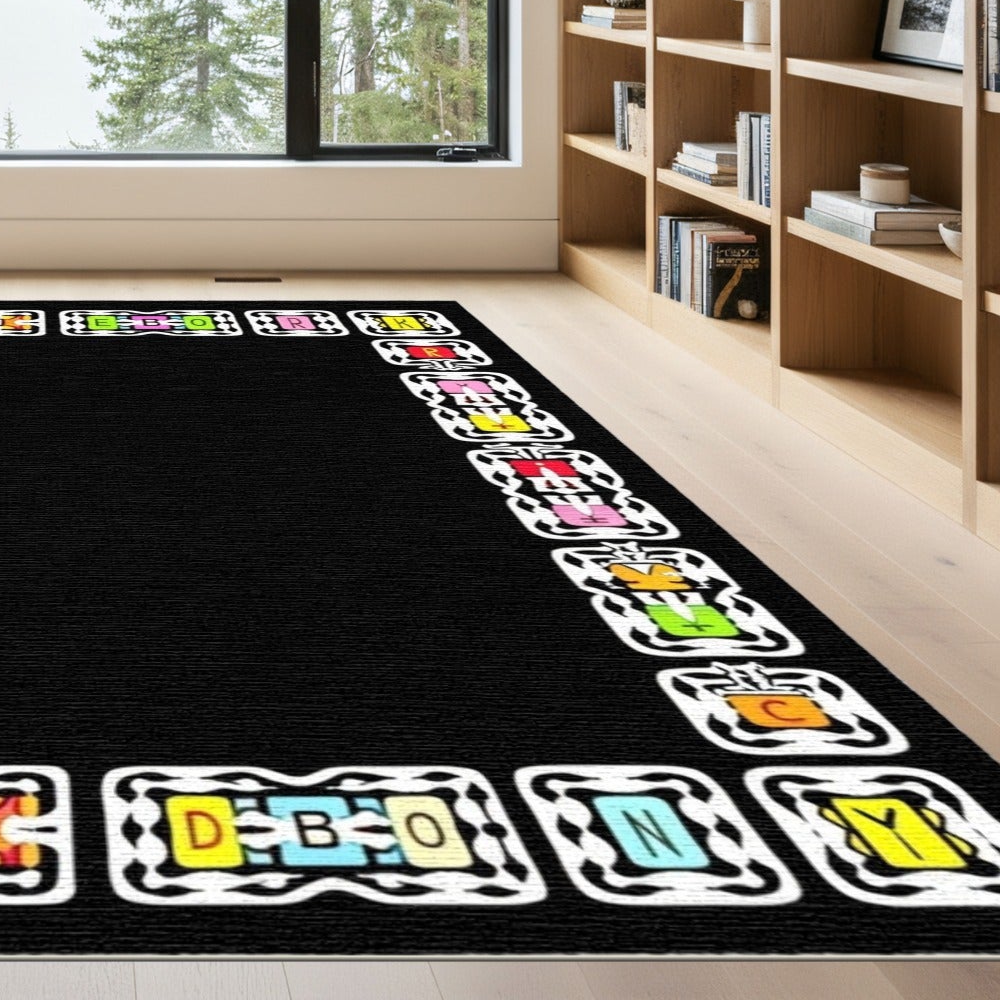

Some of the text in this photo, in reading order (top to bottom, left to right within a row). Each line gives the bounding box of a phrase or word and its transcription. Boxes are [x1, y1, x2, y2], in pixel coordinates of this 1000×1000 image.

[288, 318, 305, 329] R
[396, 318, 414, 329] K
[425, 347, 442, 358] R
[620, 809, 683, 858] N
[852, 808, 924, 861] Y
